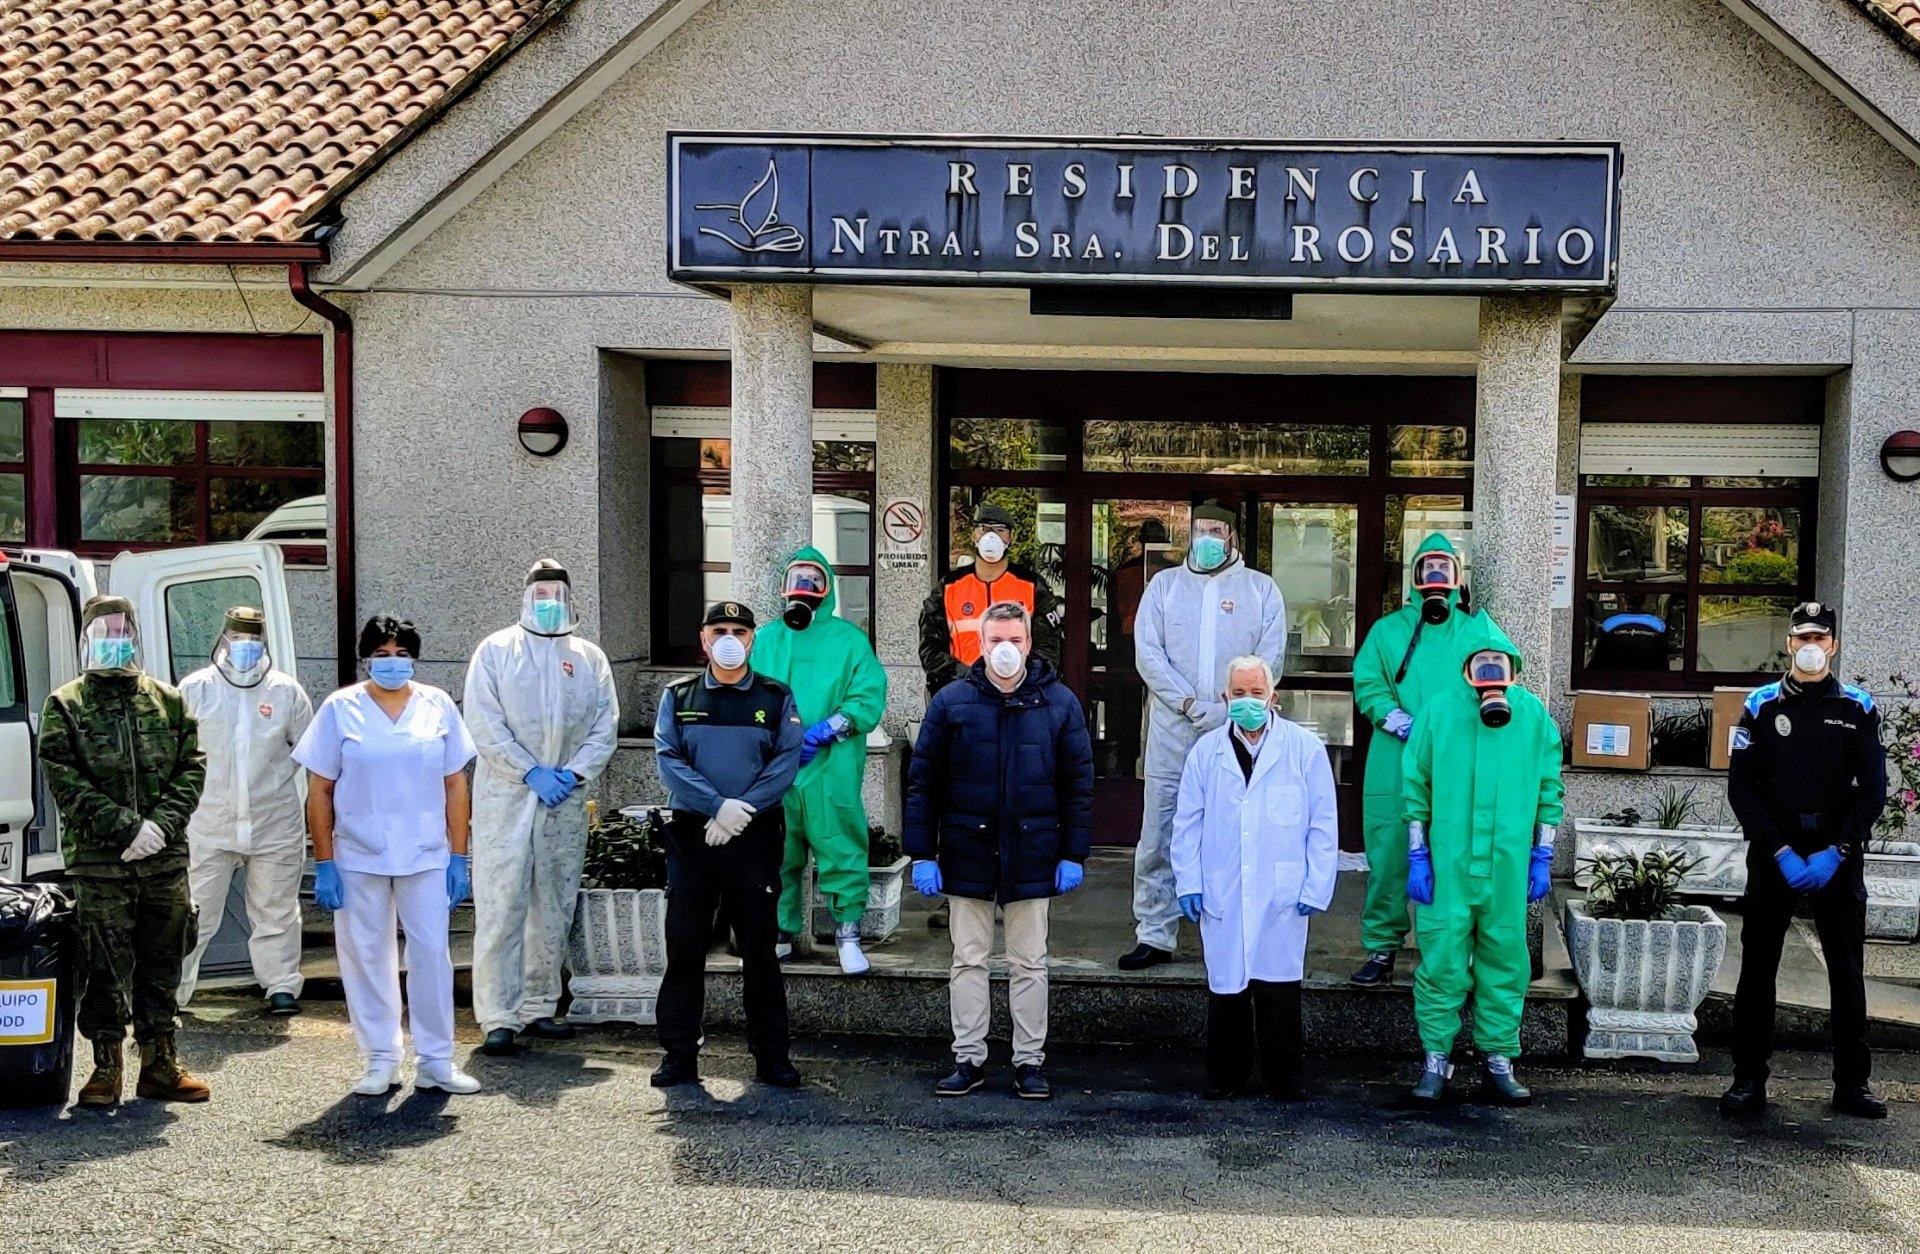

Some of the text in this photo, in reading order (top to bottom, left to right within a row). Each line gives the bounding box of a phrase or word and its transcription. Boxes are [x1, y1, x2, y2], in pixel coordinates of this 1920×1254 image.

[947, 162, 1488, 204] RESIDENCIA
[831, 217, 1596, 265] NTRA. SRA. DEL ROSARIO
[892, 561, 919, 569] UMAR
[0, 994, 38, 1007] UIPO
[0, 1015, 25, 1027] DD
